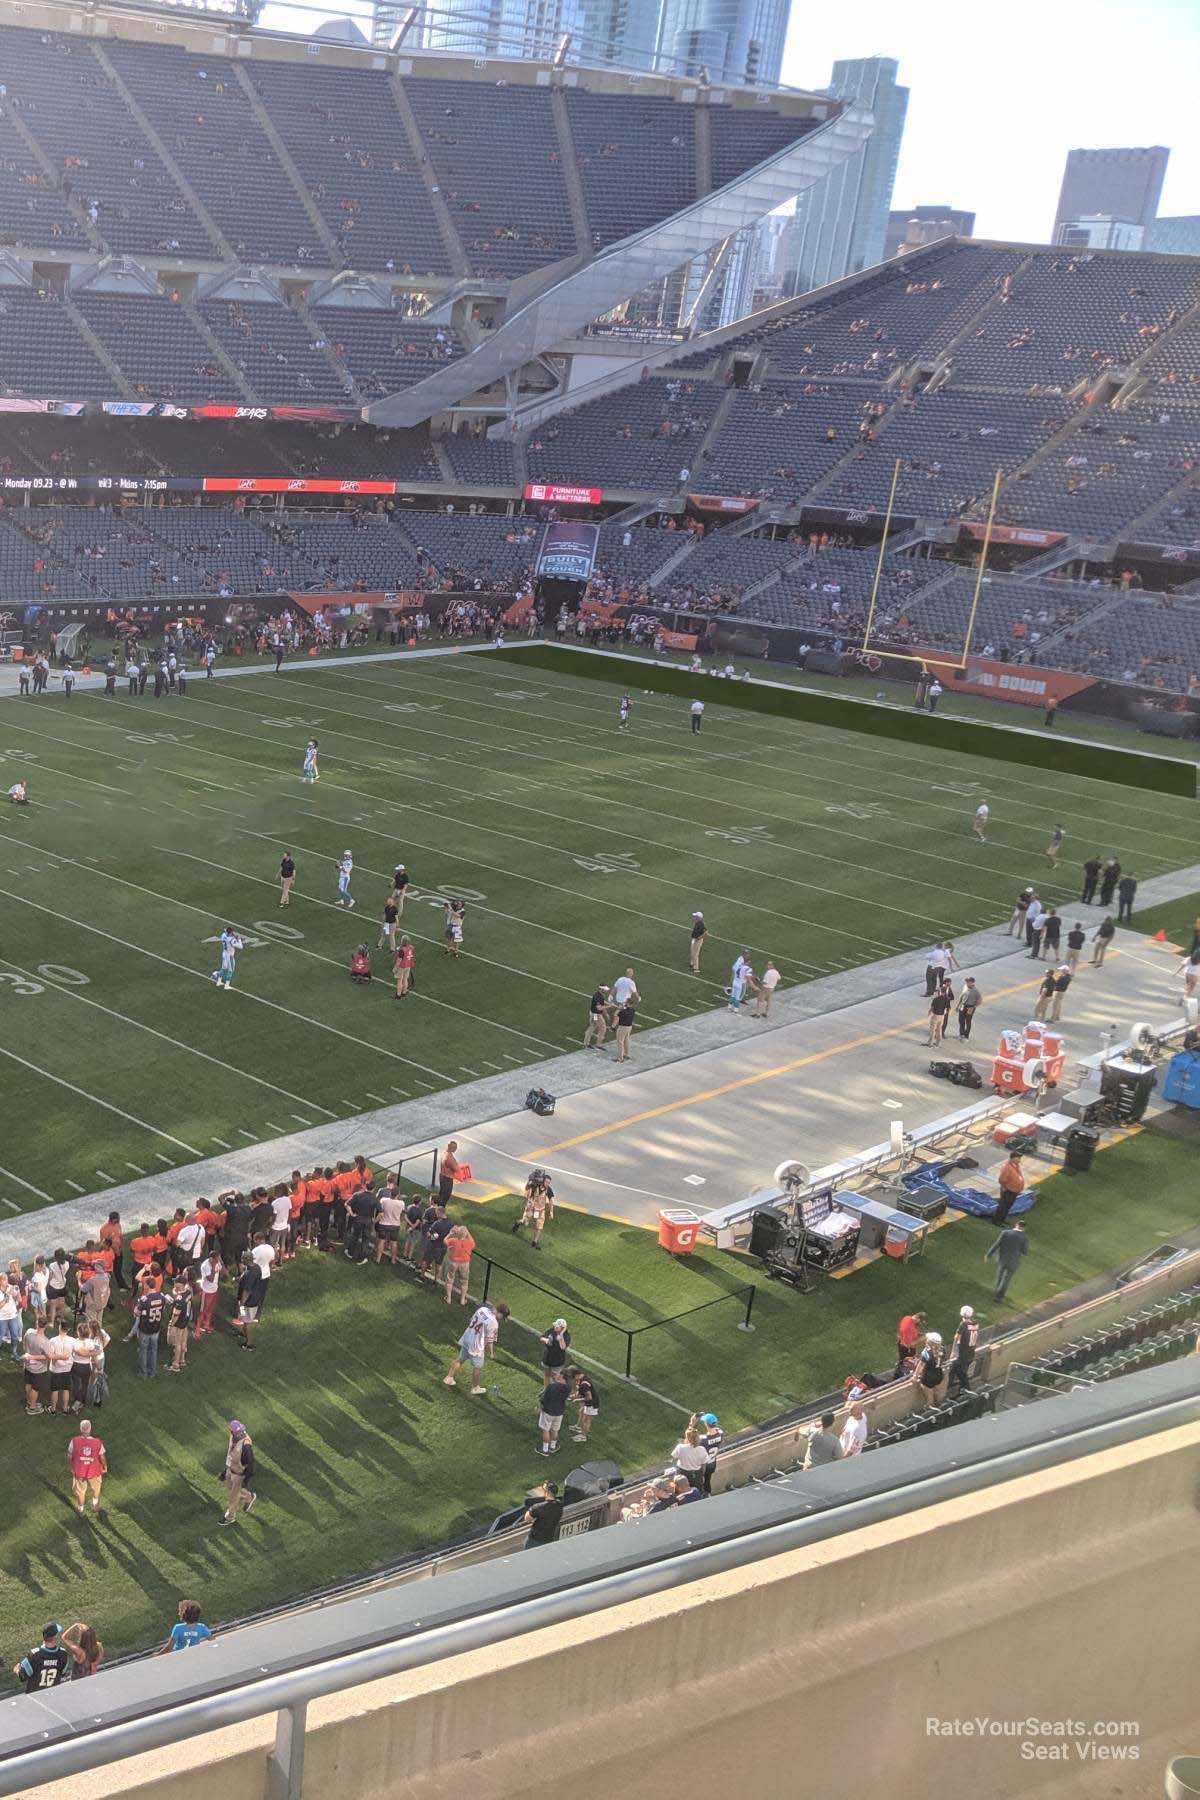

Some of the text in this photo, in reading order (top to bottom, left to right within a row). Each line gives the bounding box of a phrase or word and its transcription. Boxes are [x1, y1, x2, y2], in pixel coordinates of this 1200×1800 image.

[5, 478, 32, 489] Monday
[33, 478, 53, 489] 09.23
[552, 488, 591, 496] FURNITURE
[555, 495, 591, 503] MATTRESS
[547, 556, 584, 564] BUILT
[677, 1229, 693, 1245] G
[149, 1307, 161, 1322] 55
[39, 1668, 58, 1687] 12
